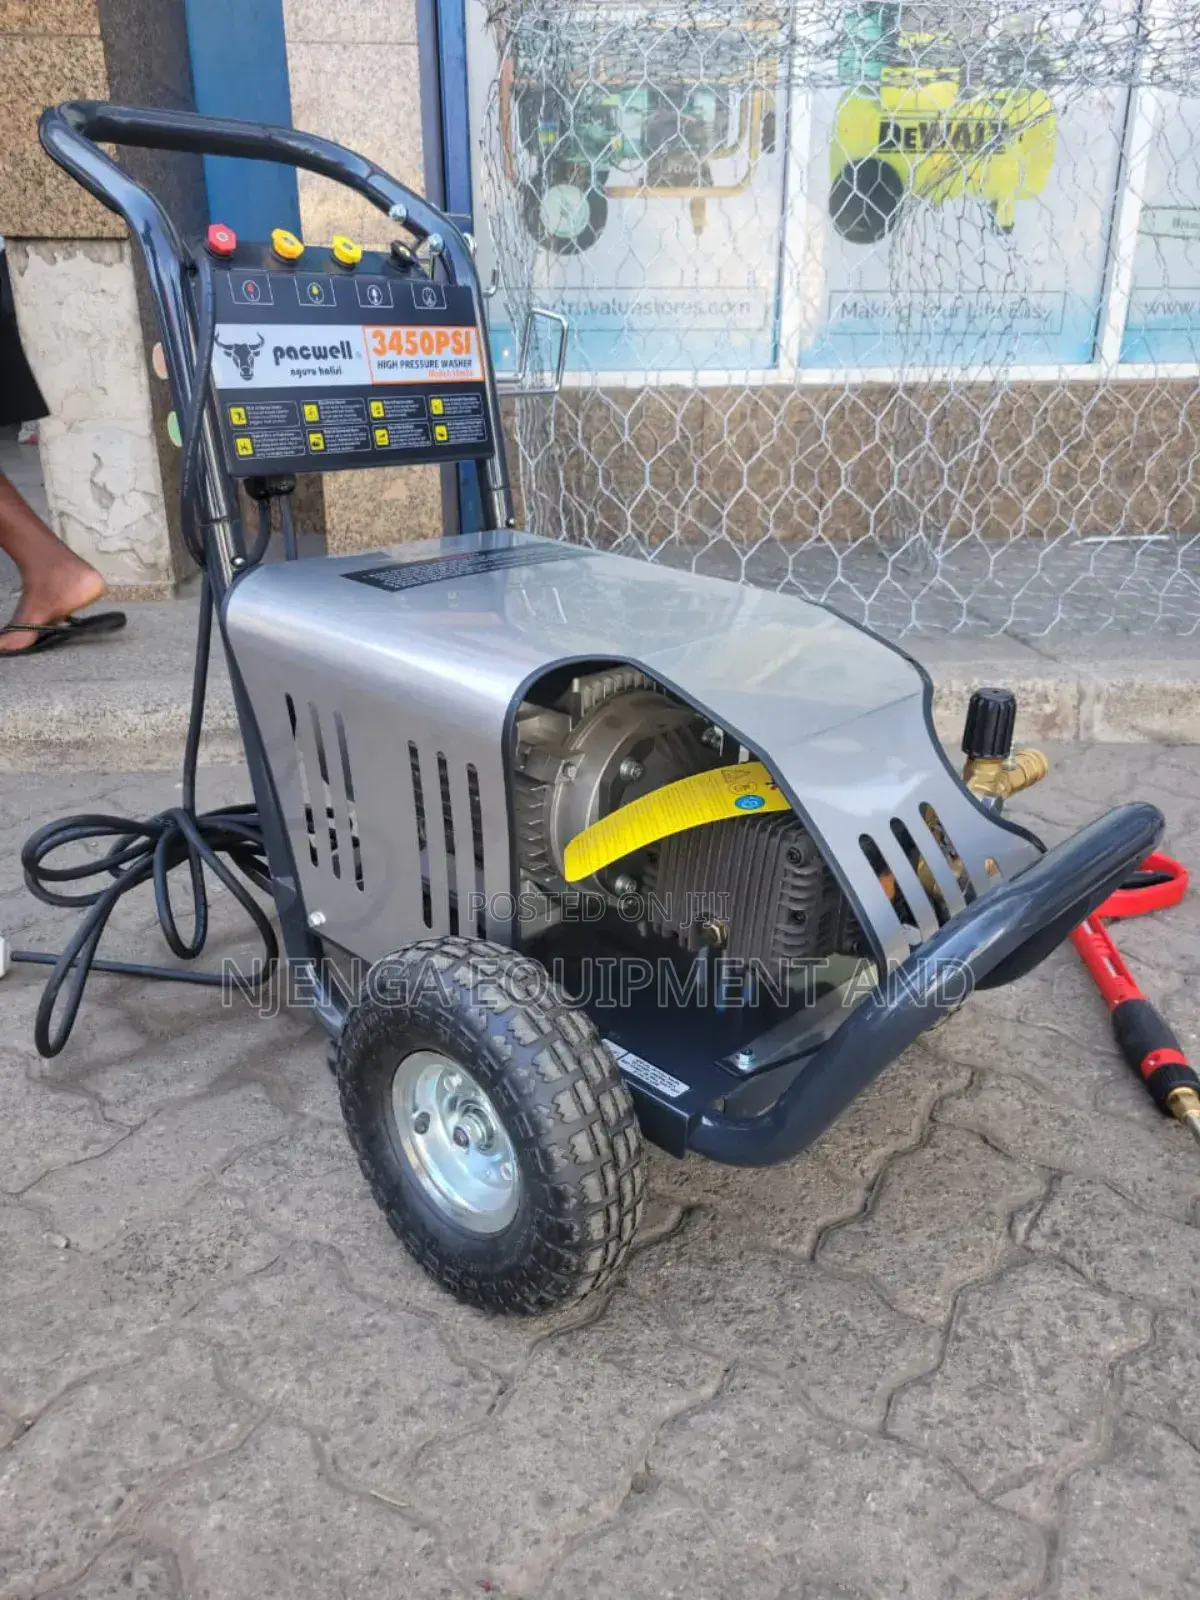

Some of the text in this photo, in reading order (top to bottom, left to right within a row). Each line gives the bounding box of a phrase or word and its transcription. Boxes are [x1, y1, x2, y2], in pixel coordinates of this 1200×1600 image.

[272, 340, 353, 366] pacwell
[371, 329, 471, 357] 3450PSI
[377, 359, 472, 369] HIGH PRESSURE WASHER
